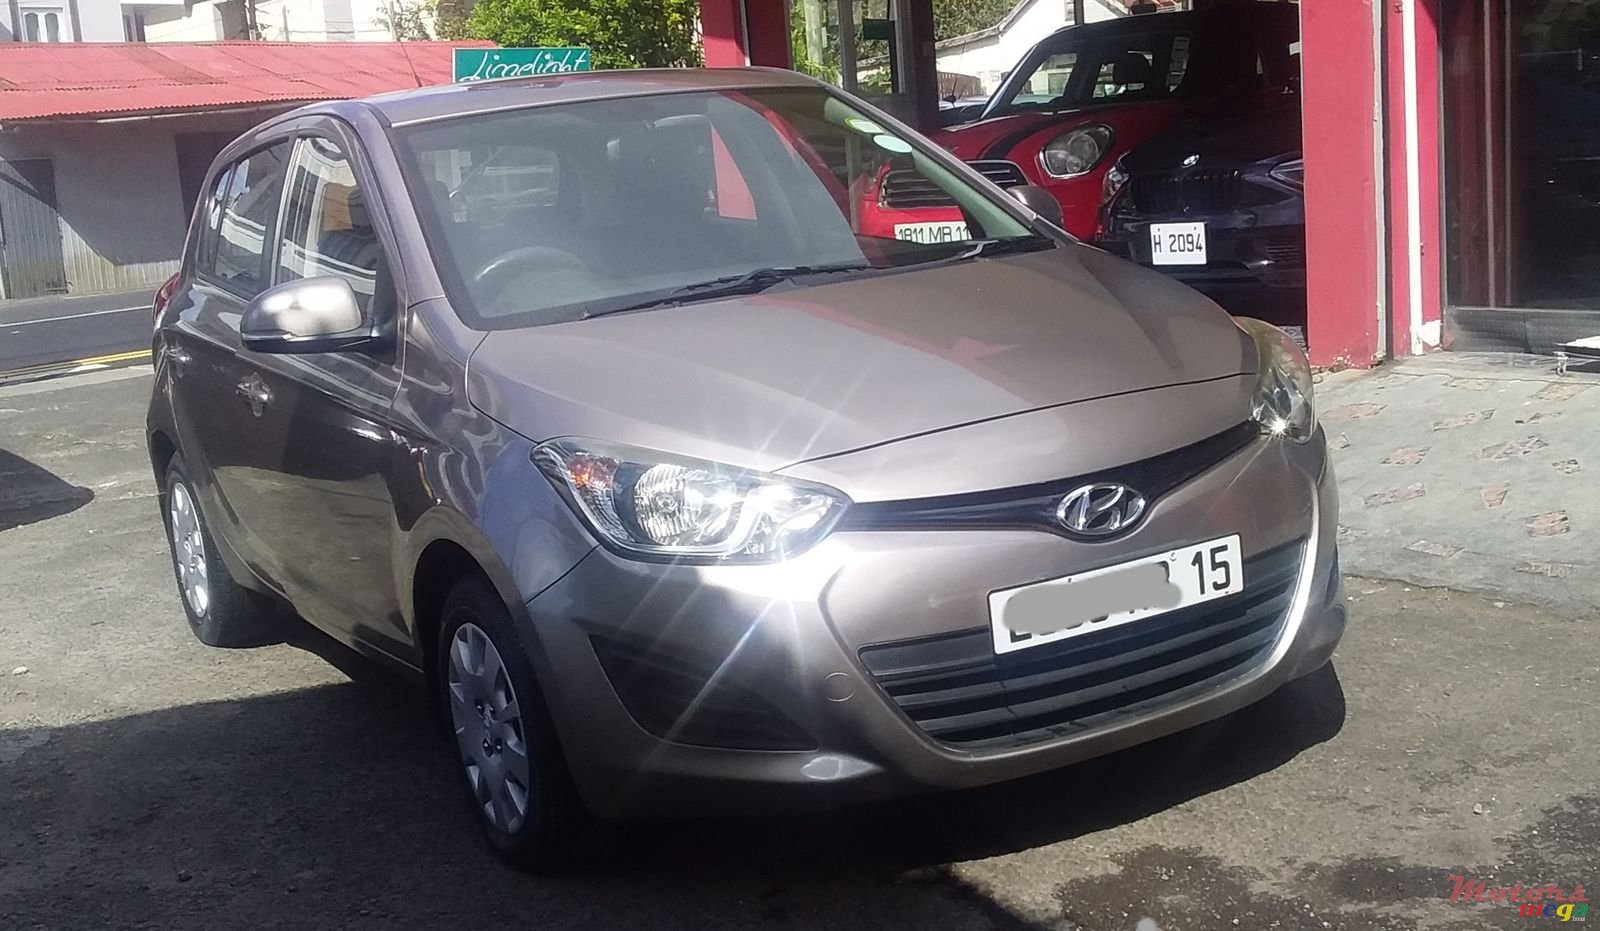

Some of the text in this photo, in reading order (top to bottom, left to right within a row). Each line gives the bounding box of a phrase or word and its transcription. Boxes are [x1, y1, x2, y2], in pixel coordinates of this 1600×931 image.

[459, 50, 587, 82] Limelight
[898, 227, 925, 242] 1811
[955, 226, 971, 241] 11
[1153, 233, 1203, 253] H 2094
[1191, 544, 1231, 595] 15
